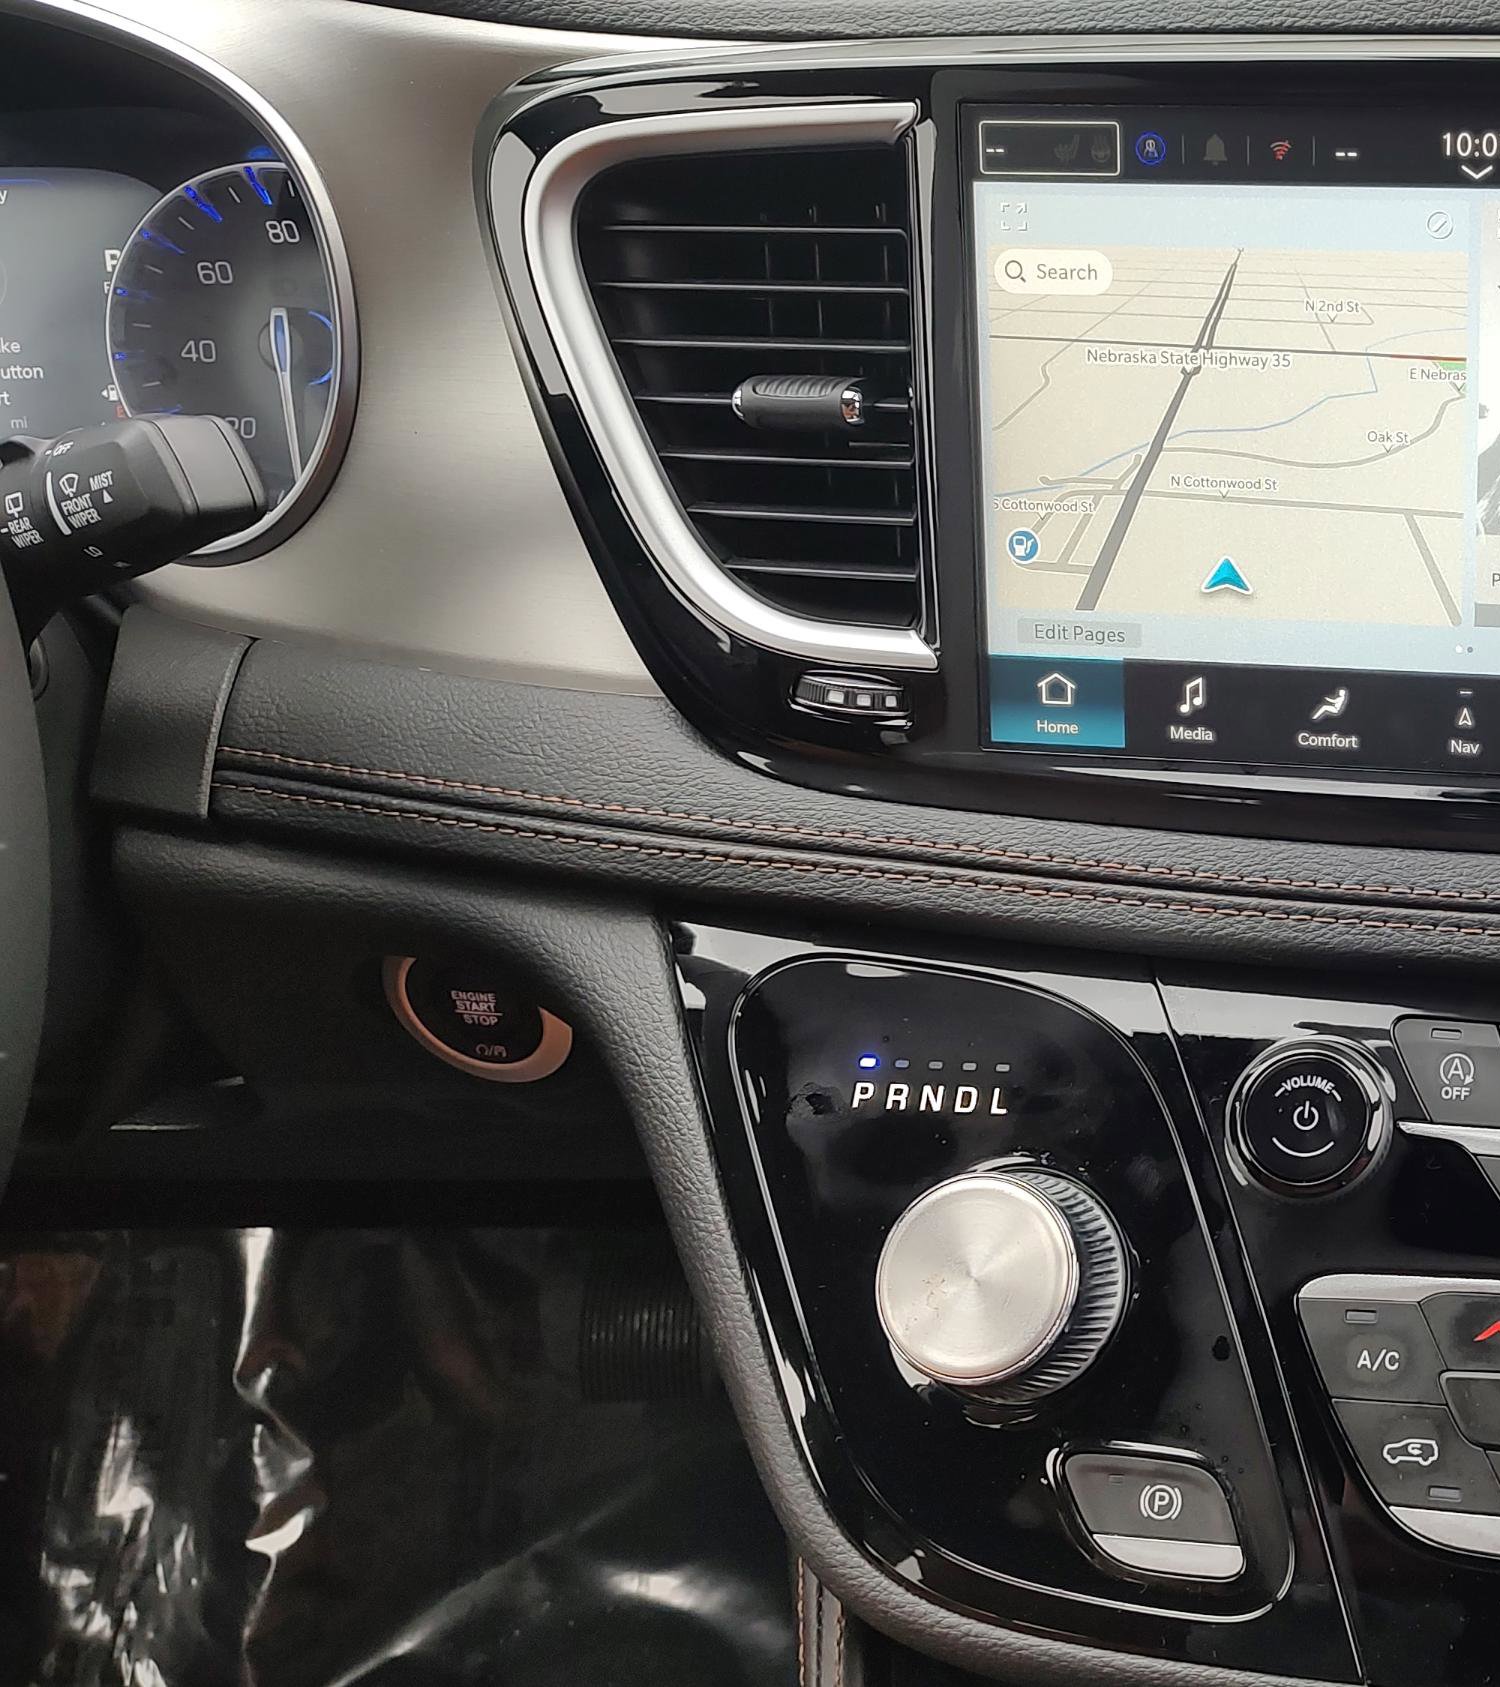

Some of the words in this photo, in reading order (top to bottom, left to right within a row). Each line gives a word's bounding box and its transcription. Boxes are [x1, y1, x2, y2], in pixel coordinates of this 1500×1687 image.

[265, 220, 300, 244] 80
[197, 261, 233, 285] 60
[1036, 262, 1099, 282] Search
[1305, 300, 1317, 312] N
[1318, 300, 1343, 313] 2nd
[1345, 301, 1360, 313] St
[180, 340, 216, 363] 40
[1086, 349, 1157, 365] Nebraska
[1160, 350, 1199, 366] State
[1202, 351, 1269, 369] Highway
[1272, 354, 1291, 368] 35
[1410, 368, 1417, 379] E
[1421, 368, 1467, 380] Nebras
[10, 416, 28, 429] mi
[1367, 430, 1390, 444] Oak
[1392, 431, 1409, 444] St
[89, 470, 114, 492] MIST
[1171, 476, 1181, 487] N
[1182, 476, 1264, 491] Cottonwood
[1265, 478, 1278, 491] St
[60, 493, 94, 516] FRONT
[1001, 498, 1078, 512] Cottonwood
[1081, 501, 1094, 512] St
[8, 517, 34, 535] REAR
[67, 508, 102, 529] WIPER
[11, 530, 45, 549] WIPER
[1034, 625, 1070, 640] Edit
[1073, 627, 1125, 645] Pages
[1036, 720, 1079, 735] Home
[1170, 726, 1213, 742] Media
[1298, 733, 1358, 749] Comfort
[1450, 741, 1480, 755] Nav
[451, 990, 497, 1003] ENGINE
[455, 1001, 496, 1013] START
[464, 1014, 498, 1026] STOP
[1281, 1075, 1334, 1094] VOLUME
[1441, 1086, 1470, 1100] OFF
[1356, 1349, 1400, 1372] A/C
